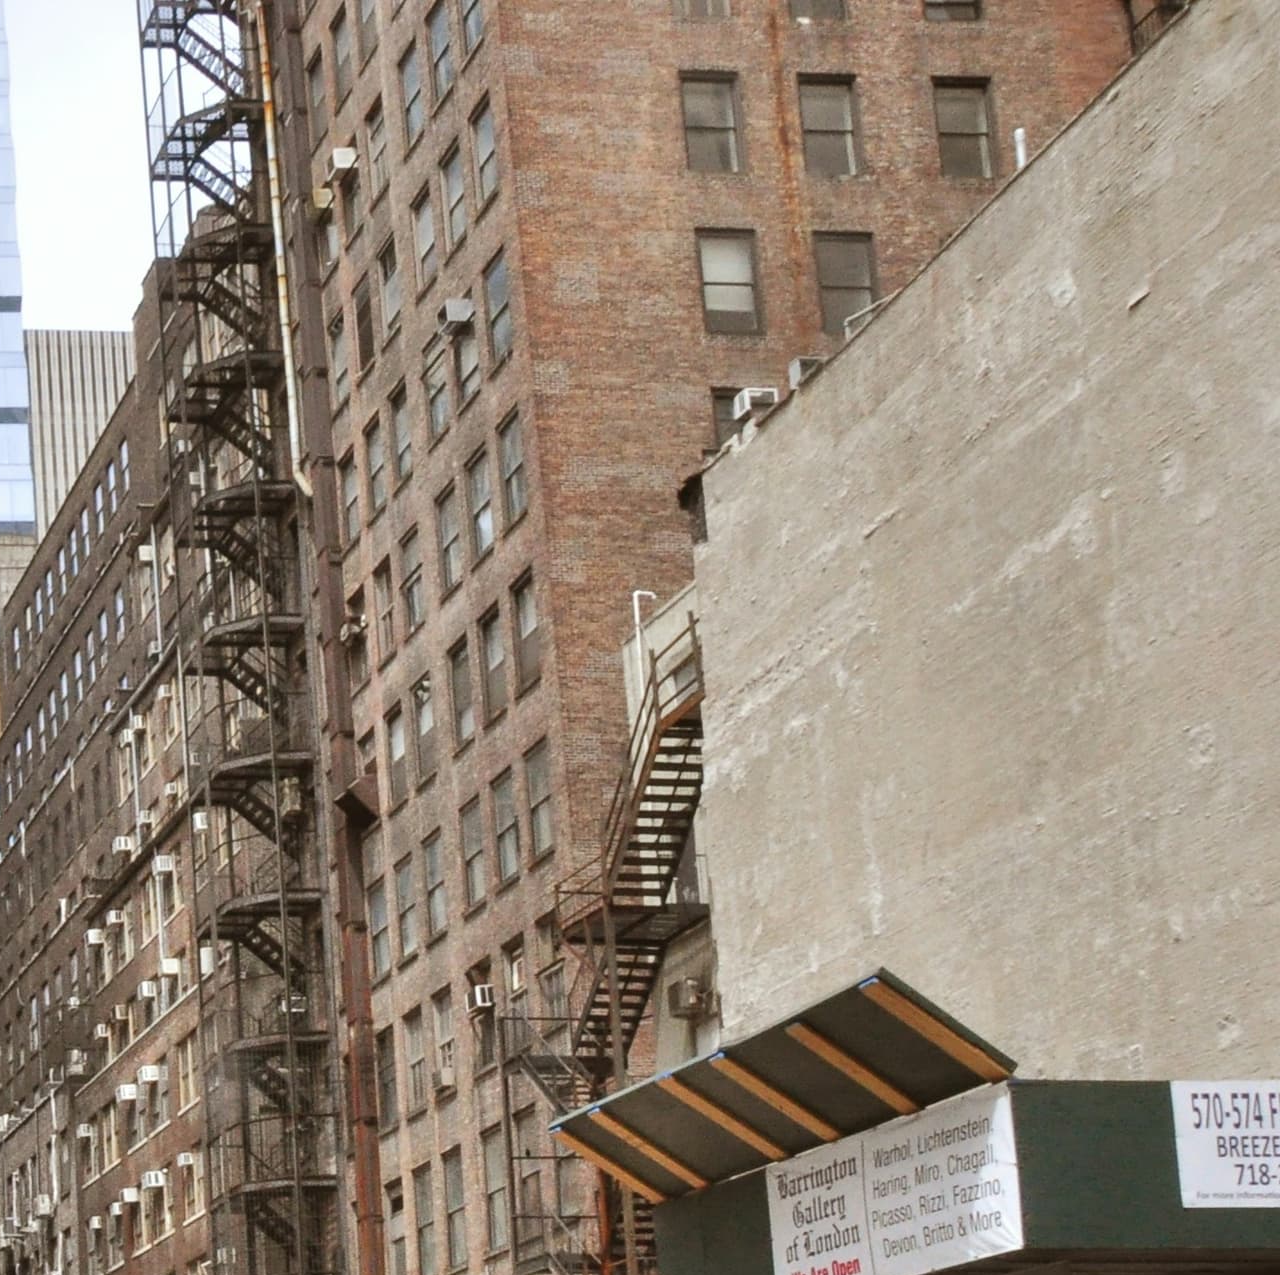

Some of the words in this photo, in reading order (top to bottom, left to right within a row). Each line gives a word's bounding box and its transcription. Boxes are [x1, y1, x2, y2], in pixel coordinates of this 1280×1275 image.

[1191, 1092, 1263, 1129] 570-574
[1268, 1092, 1280, 1129] F
[872, 1138, 914, 1168] Warhol,
[947, 1143, 999, 1176] Chagall,
[1217, 1136, 1280, 1158] BREEZE
[777, 1156, 857, 1200] Barrington
[1234, 1163, 1280, 1186] 718-
[952, 1178, 1005, 1207] Fazzino,
[792, 1194, 847, 1229] Gallery
[922, 1222, 954, 1247] Britto
[958, 1215, 967, 1237] &
[969, 1210, 1002, 1233] More
[785, 1235, 799, 1264] of
[802, 1223, 861, 1257] London
